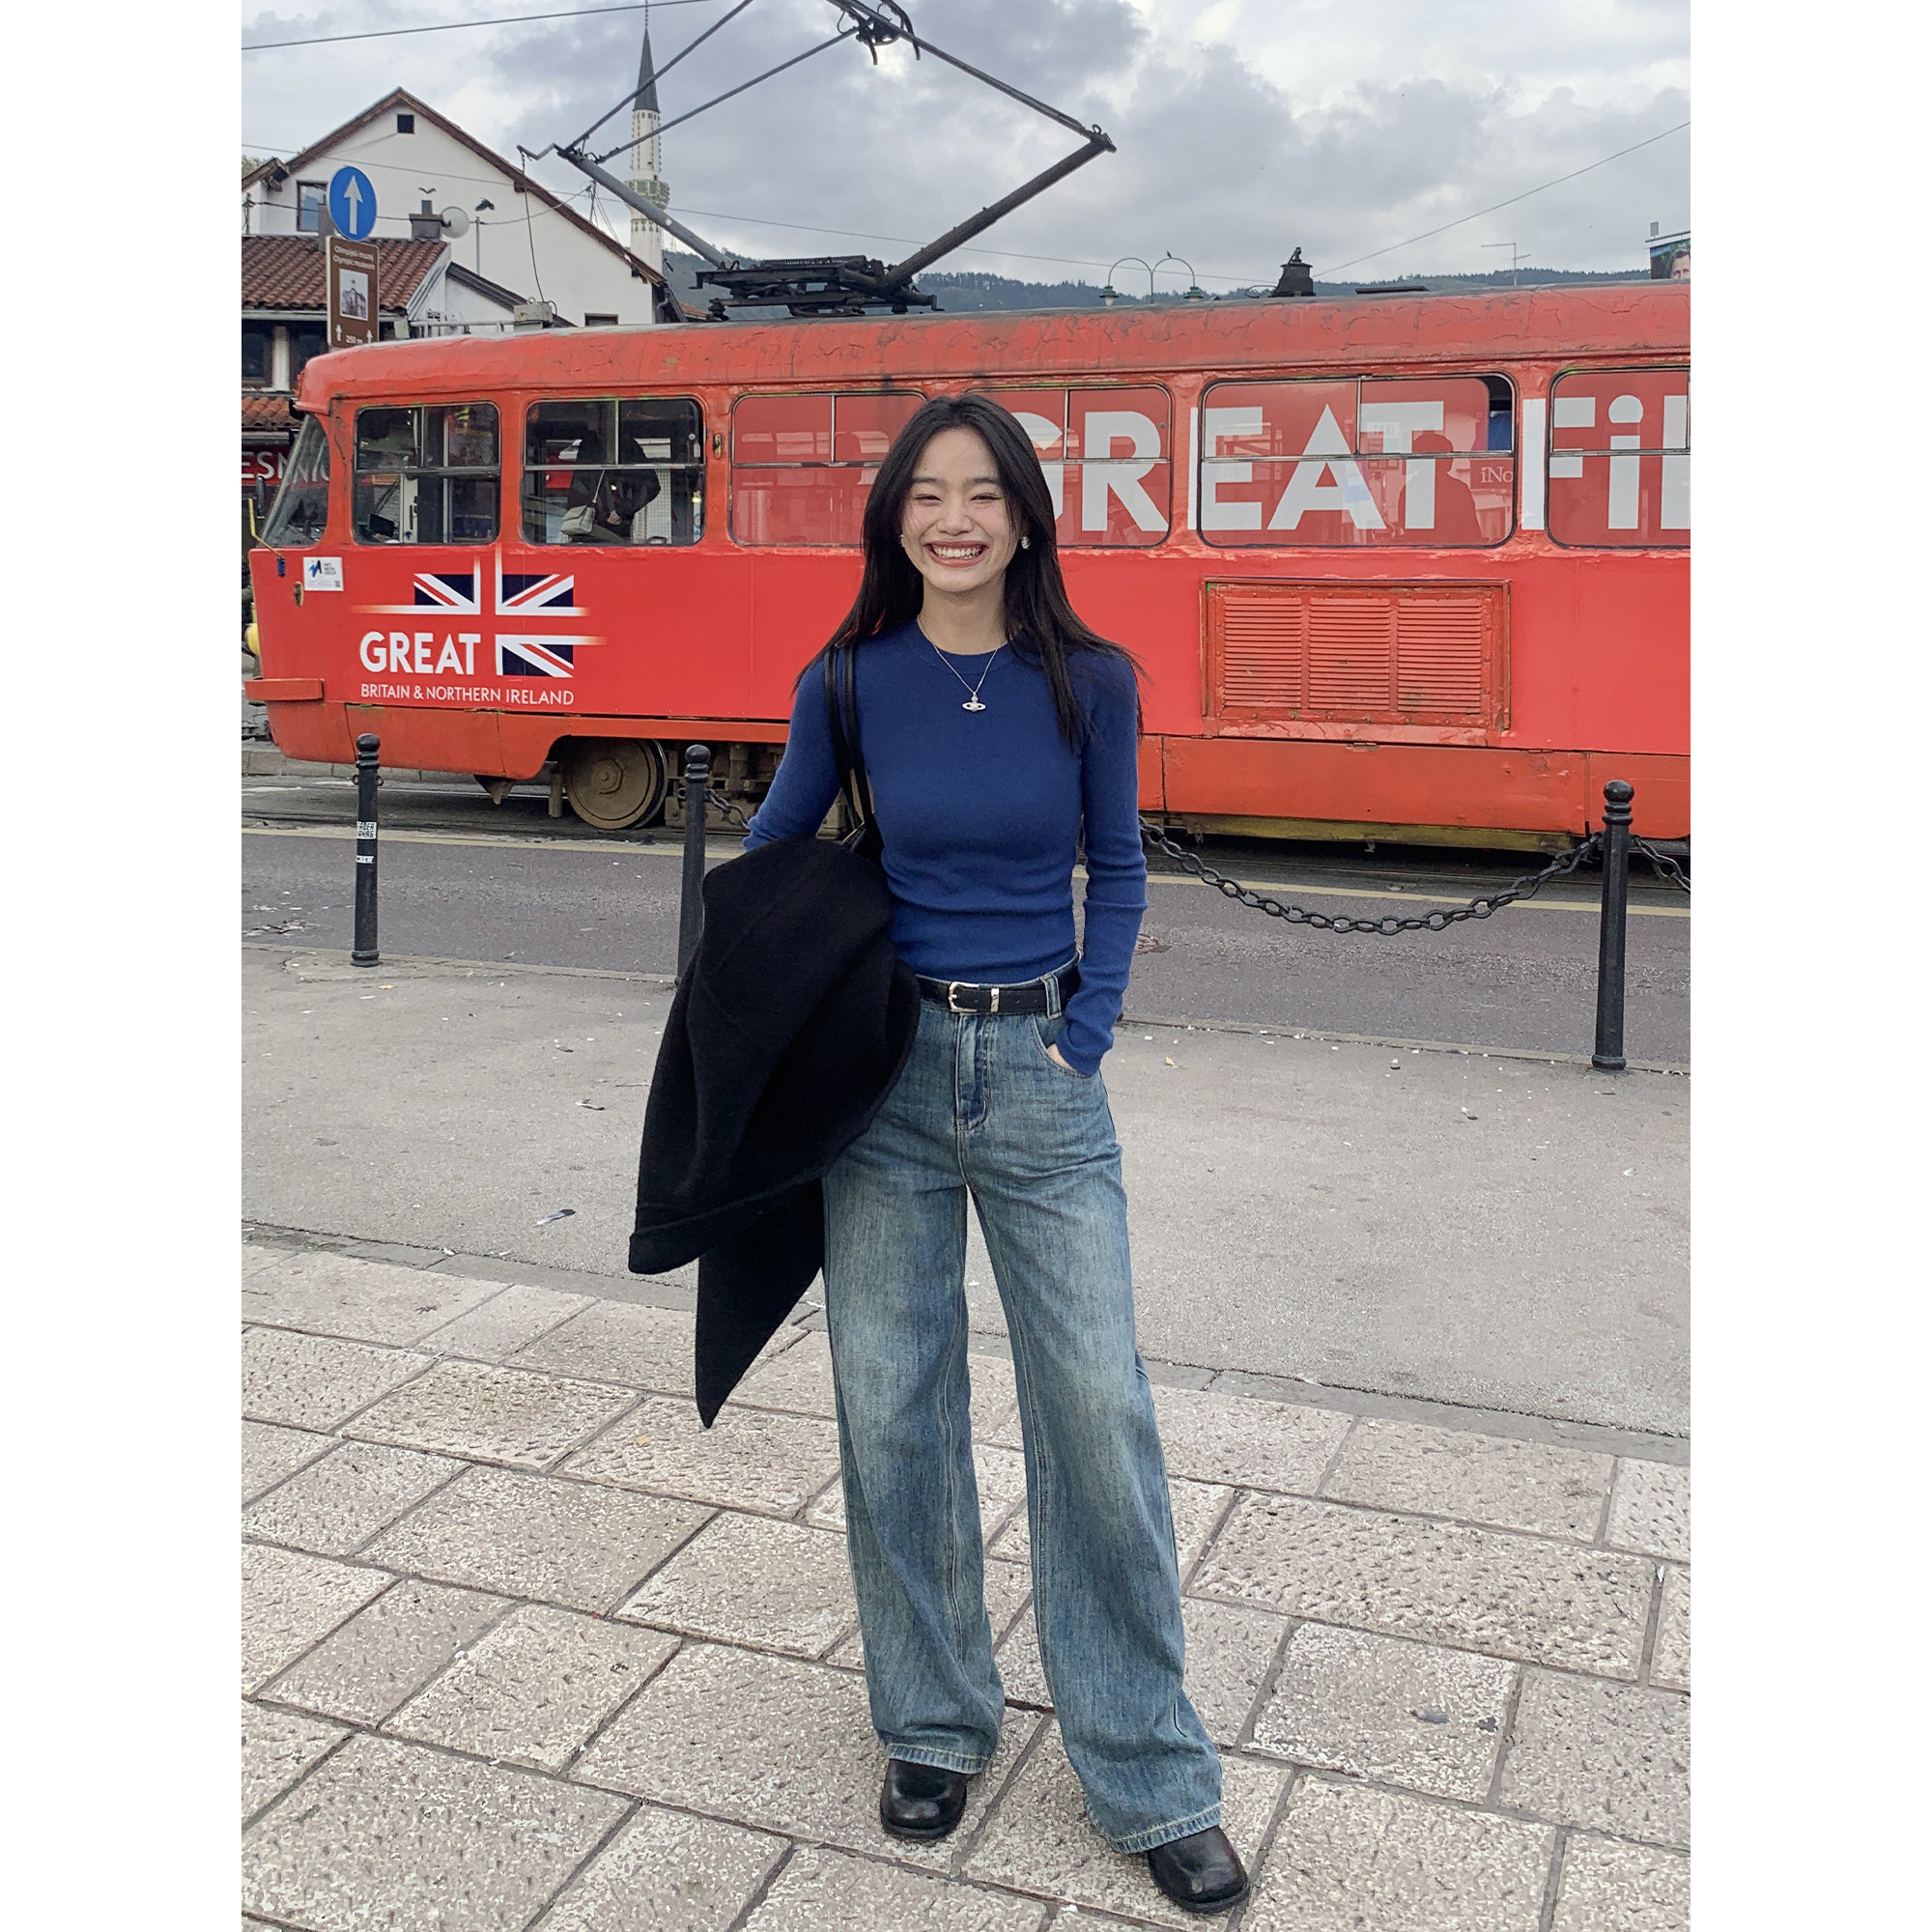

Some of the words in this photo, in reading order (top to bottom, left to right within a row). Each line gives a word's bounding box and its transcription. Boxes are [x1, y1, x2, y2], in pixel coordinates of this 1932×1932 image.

[359, 631, 481, 675] GREAT
[360, 683, 411, 698] BRITAIN
[412, 686, 424, 699] &
[426, 685, 501, 702] NORTHERN
[505, 688, 574, 705] IRELAND
